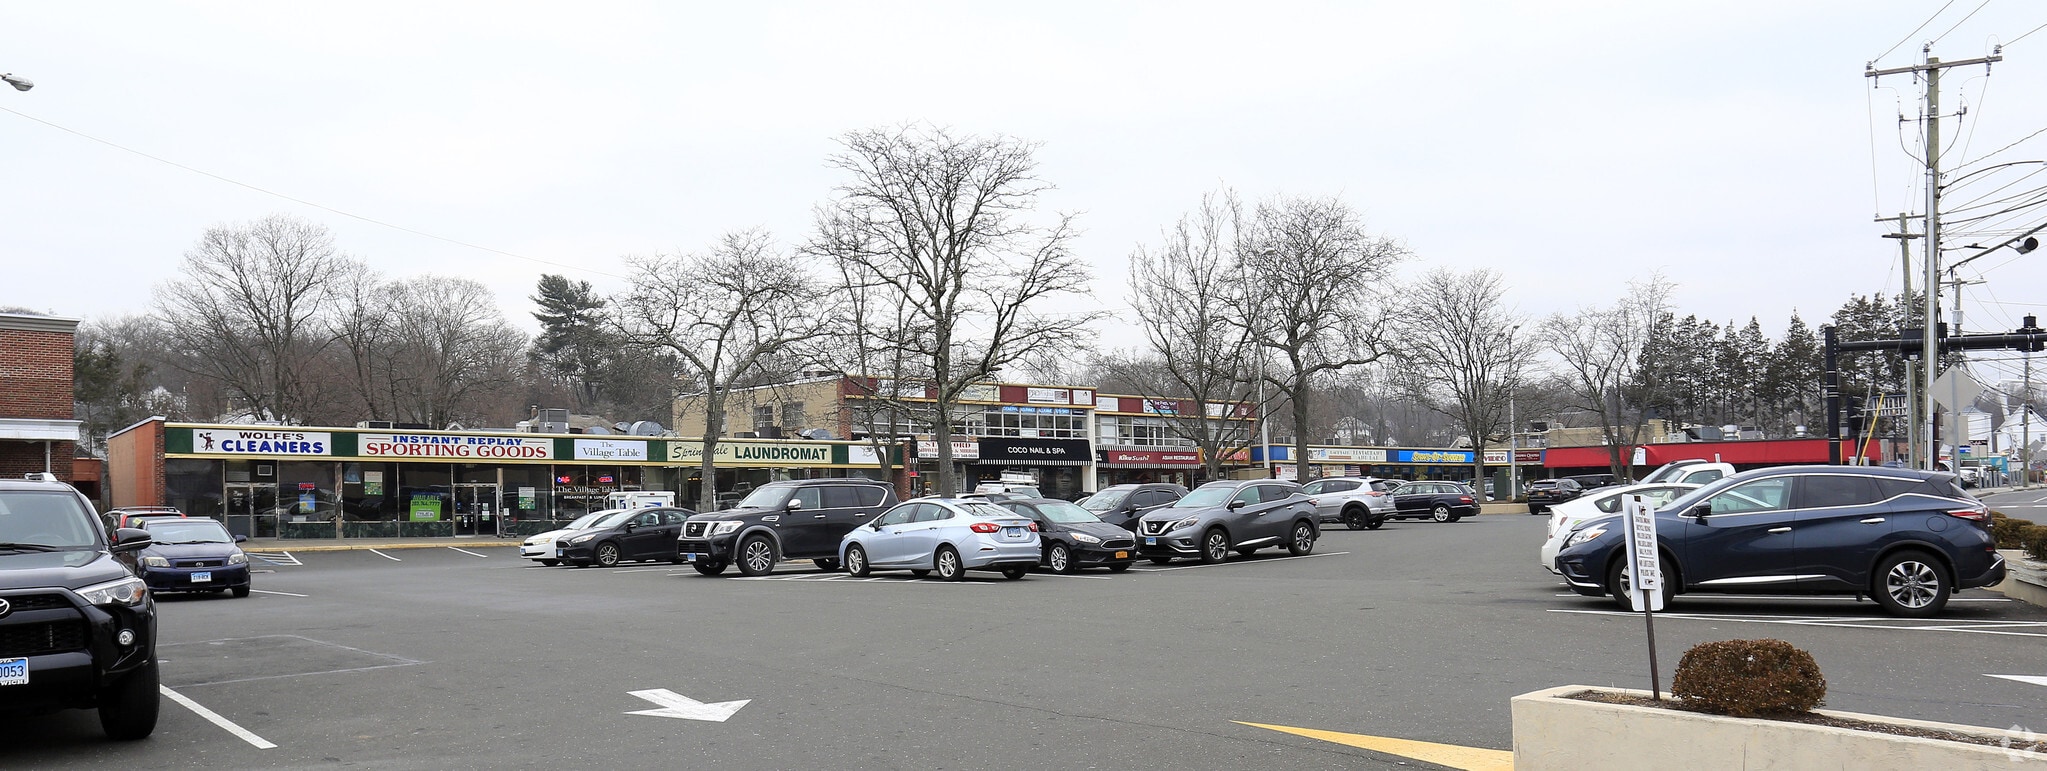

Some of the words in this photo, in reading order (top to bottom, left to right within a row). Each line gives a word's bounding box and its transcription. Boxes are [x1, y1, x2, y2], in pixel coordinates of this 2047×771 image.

[238, 432, 304, 440] WOLFE'S
[392, 435, 460, 444] INSTANT
[467, 437, 522, 446] REPLAY
[221, 440, 324, 454] CLEANERS
[366, 442, 470, 456] SPORTING
[476, 445, 547, 458] GOODS
[582, 448, 614, 458] Village
[616, 448, 640, 457] Table
[672, 444, 728, 460] Sprinale
[735, 447, 827, 460] LAUNDROMAT
